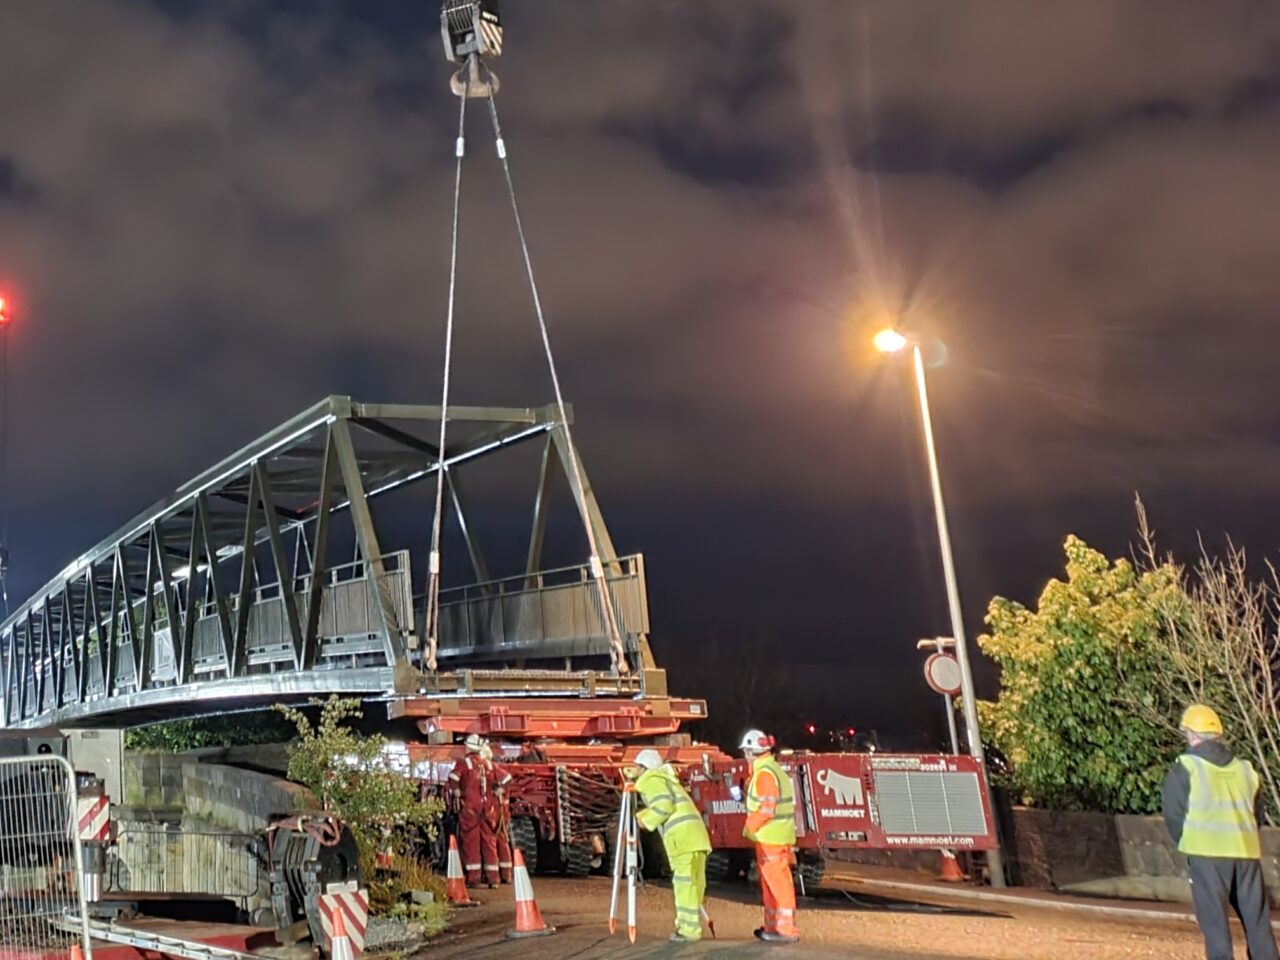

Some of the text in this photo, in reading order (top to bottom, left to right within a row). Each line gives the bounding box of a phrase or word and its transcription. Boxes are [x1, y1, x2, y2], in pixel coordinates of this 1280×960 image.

[712, 799, 746, 815] MAMMOE
[821, 808, 865, 819] MAMMOET
[886, 836, 975, 845] www.mammoet.com
